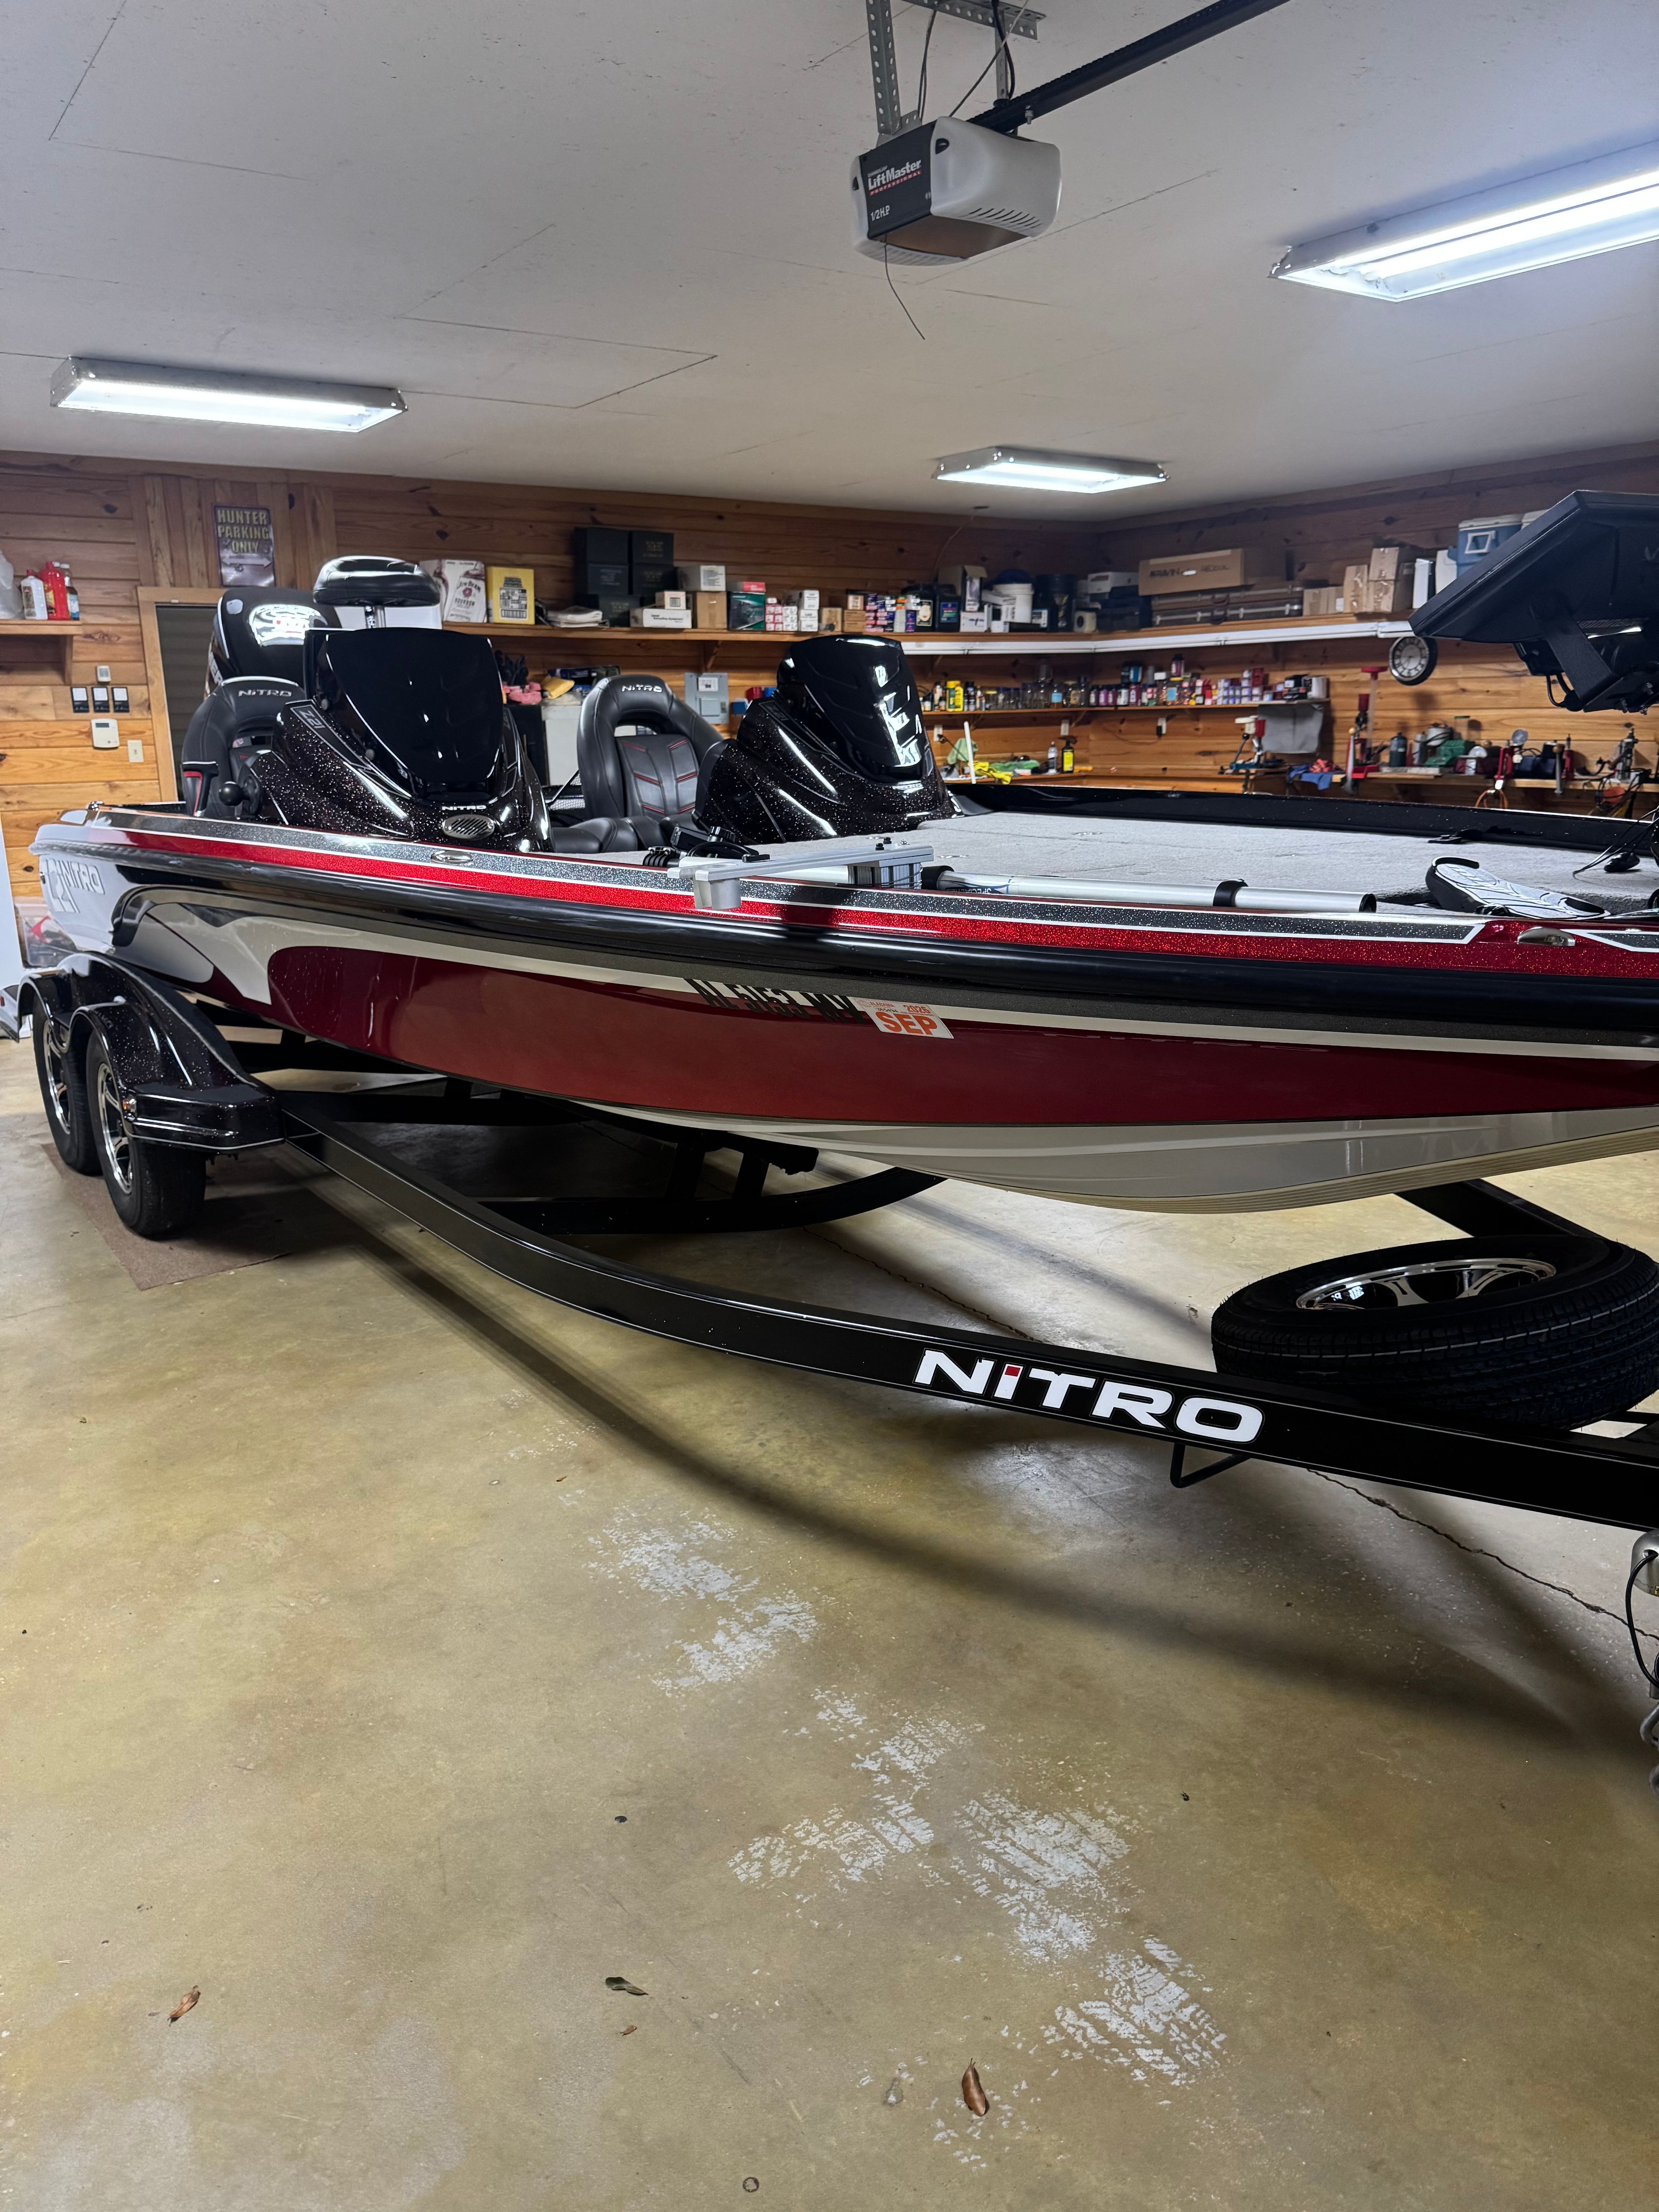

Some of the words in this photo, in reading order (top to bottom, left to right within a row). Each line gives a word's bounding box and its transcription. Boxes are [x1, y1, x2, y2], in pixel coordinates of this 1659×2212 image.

[868, 160, 921, 191] LiftMaster
[870, 171, 921, 195] PROFESSIONAL
[217, 509, 266, 525] HUNTER
[217, 526, 269, 539] PARKING
[232, 541, 259, 553] ONLY
[299, 709, 326, 729] Z21
[61, 859, 105, 895] NITRO
[684, 978, 740, 1010] AL
[799, 991, 867, 1025] MV
[903, 1005, 931, 1013] 2026
[876, 1012, 938, 1035] SEP
[914, 1348, 1263, 1443] NITRO
